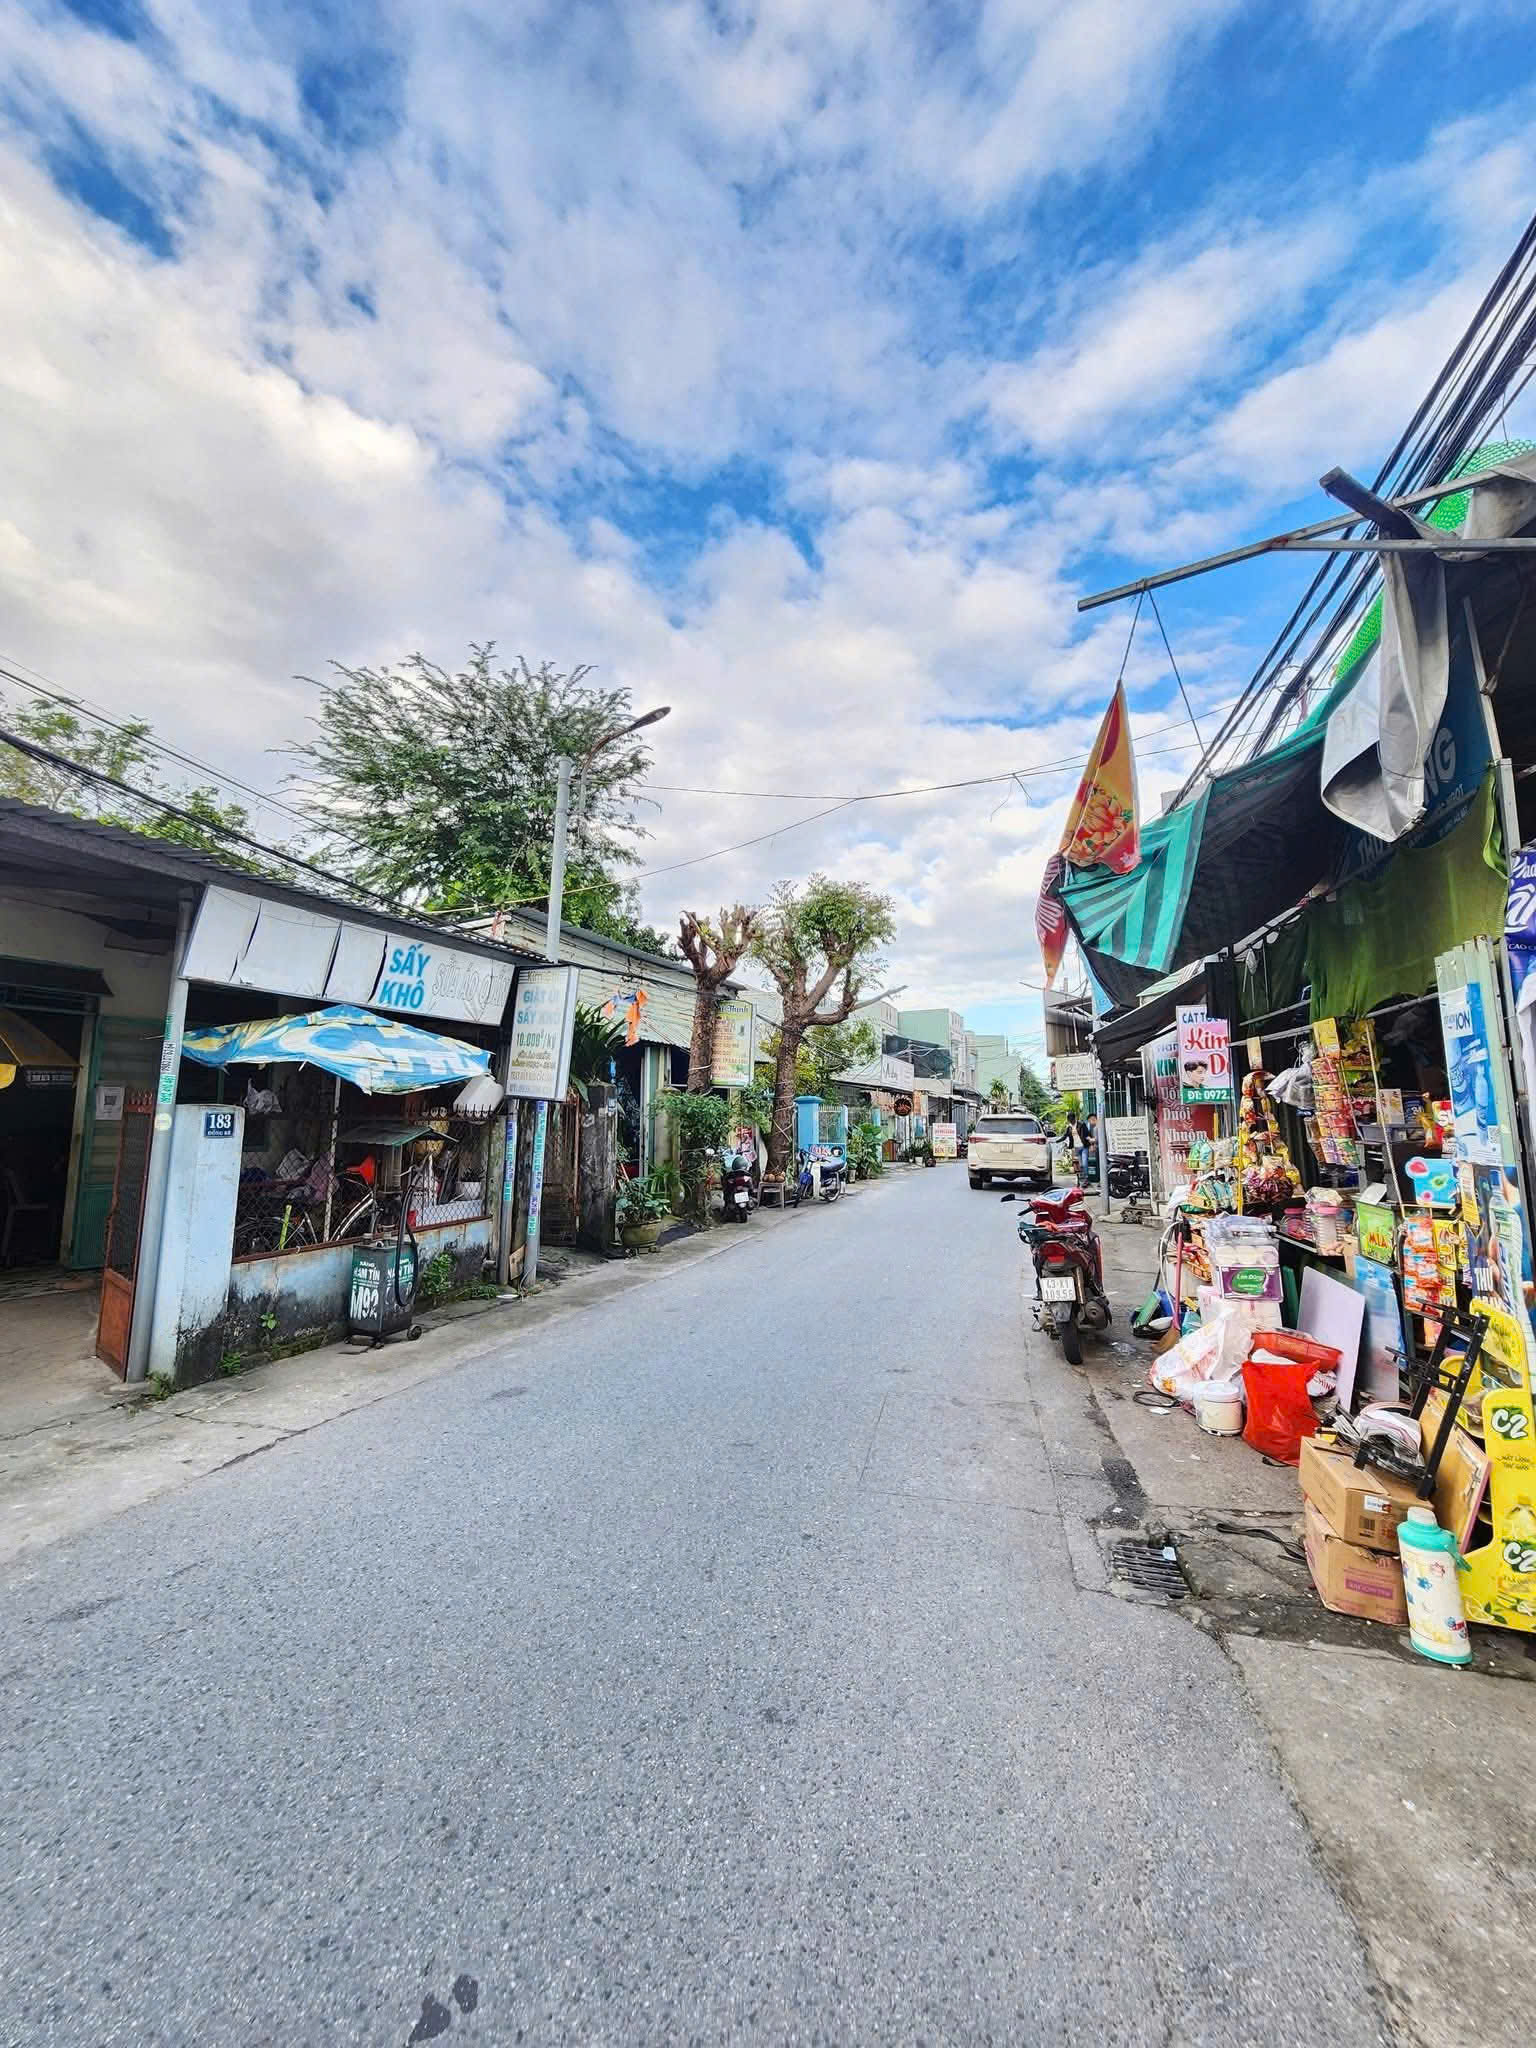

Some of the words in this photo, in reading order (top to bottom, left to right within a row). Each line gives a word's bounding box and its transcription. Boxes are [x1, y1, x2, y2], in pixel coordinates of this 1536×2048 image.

[389, 943, 431, 982] SẤY
[379, 981, 426, 1009] KHÔ
[209, 1113, 231, 1129] 183
[1491, 1408, 1529, 1439] C2
